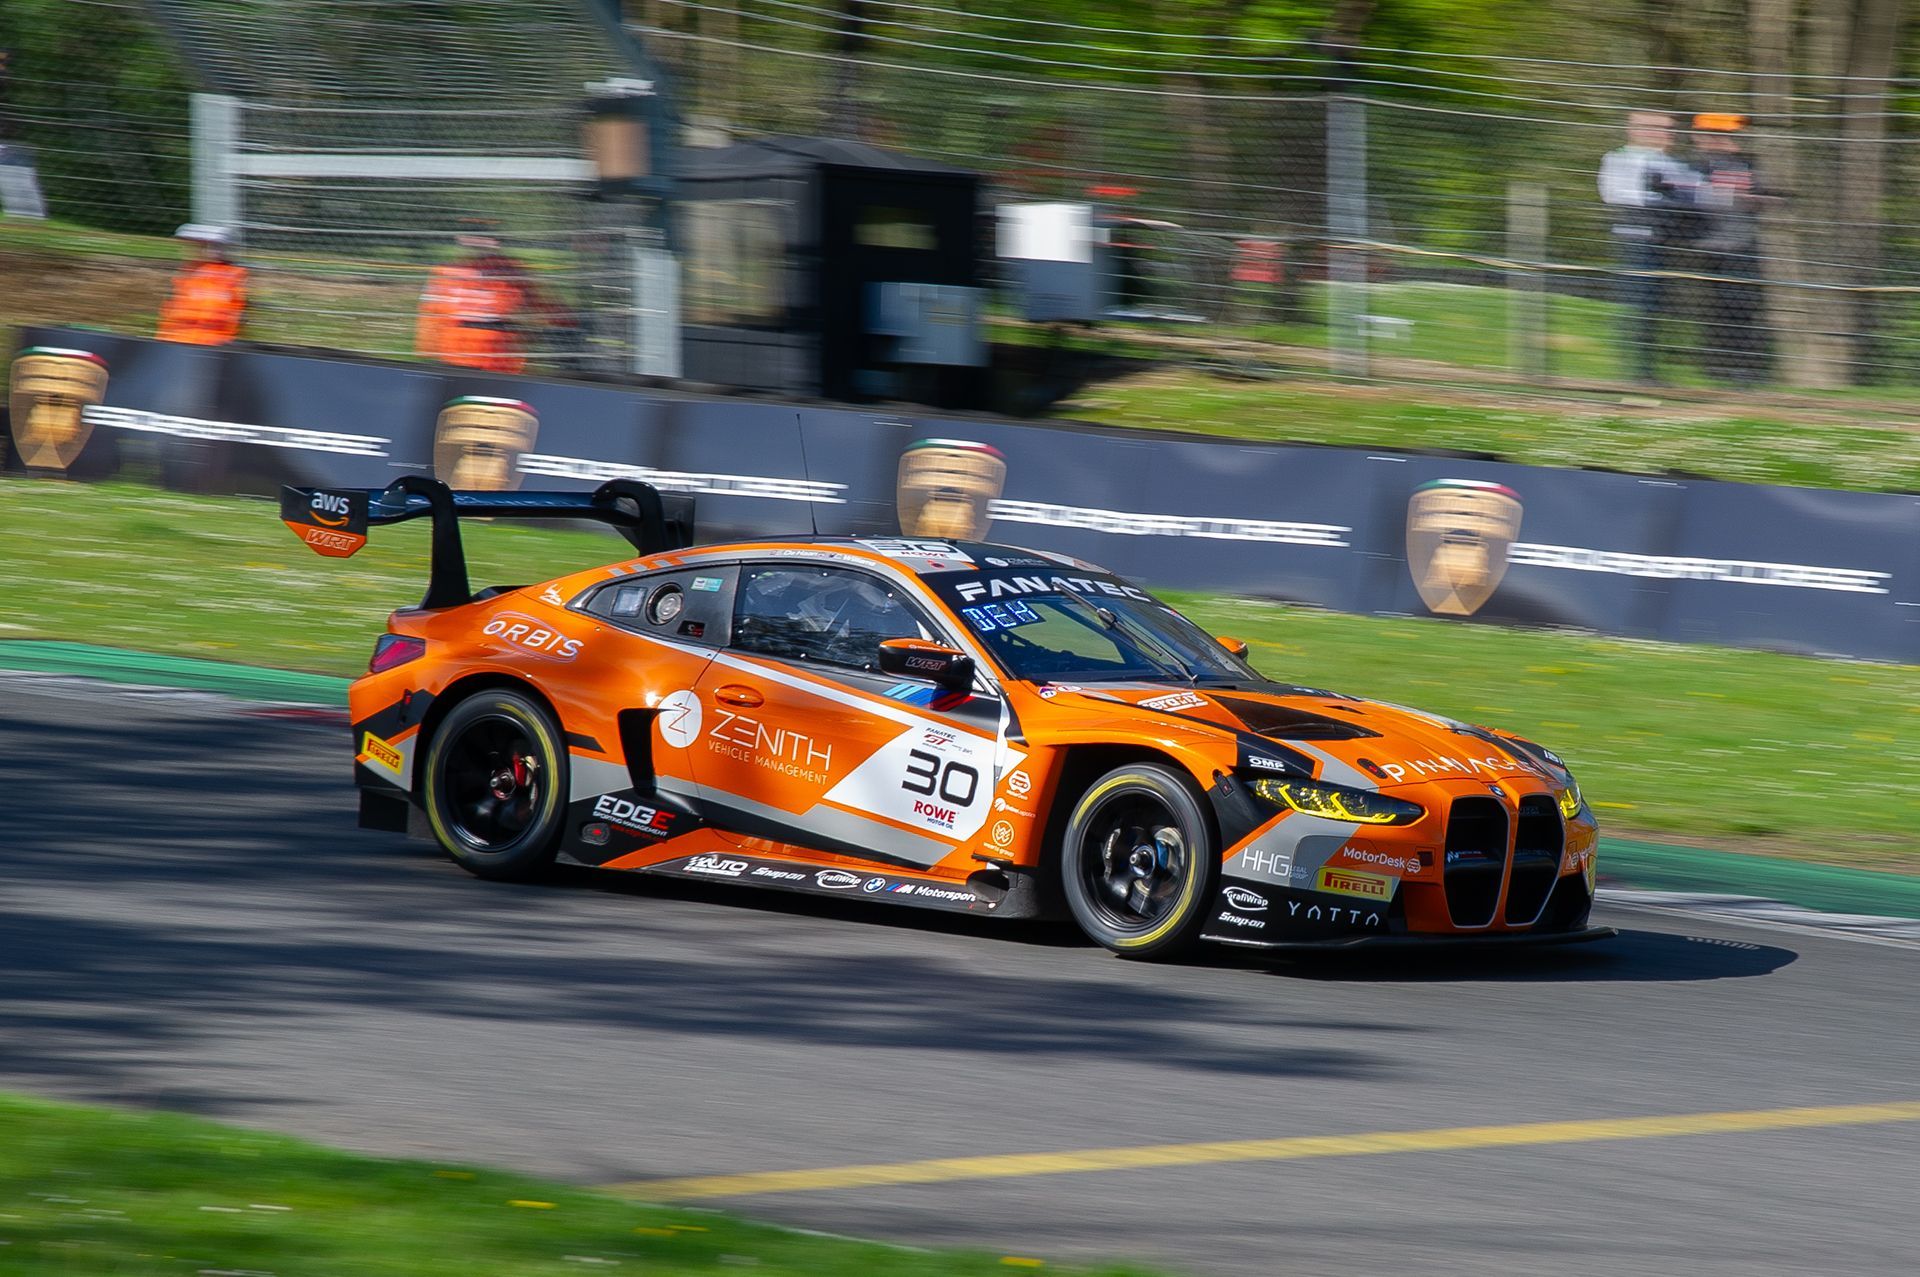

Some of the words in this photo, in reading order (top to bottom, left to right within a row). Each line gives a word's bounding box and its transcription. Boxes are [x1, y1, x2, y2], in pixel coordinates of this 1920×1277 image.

[311, 492, 350, 515] aws
[304, 529, 358, 551] WRT
[955, 576, 1151, 602] FANATEC
[483, 621, 584, 656] ORBIS
[710, 709, 832, 771] ZENITH
[925, 727, 957, 740] FANATEC
[708, 740, 750, 762] VEHICLE
[755, 756, 828, 785] MANAGEMENT
[901, 748, 979, 807] 30
[594, 795, 676, 830] EDGE
[914, 800, 956, 823] ROWE
[1242, 848, 1290, 876] HHG
[1343, 846, 1405, 869] MotorDesk
[1324, 871, 1386, 896] PIRELLI
[1227, 890, 1269, 907] GrafiWrap
[1218, 911, 1266, 929] Snap-on
